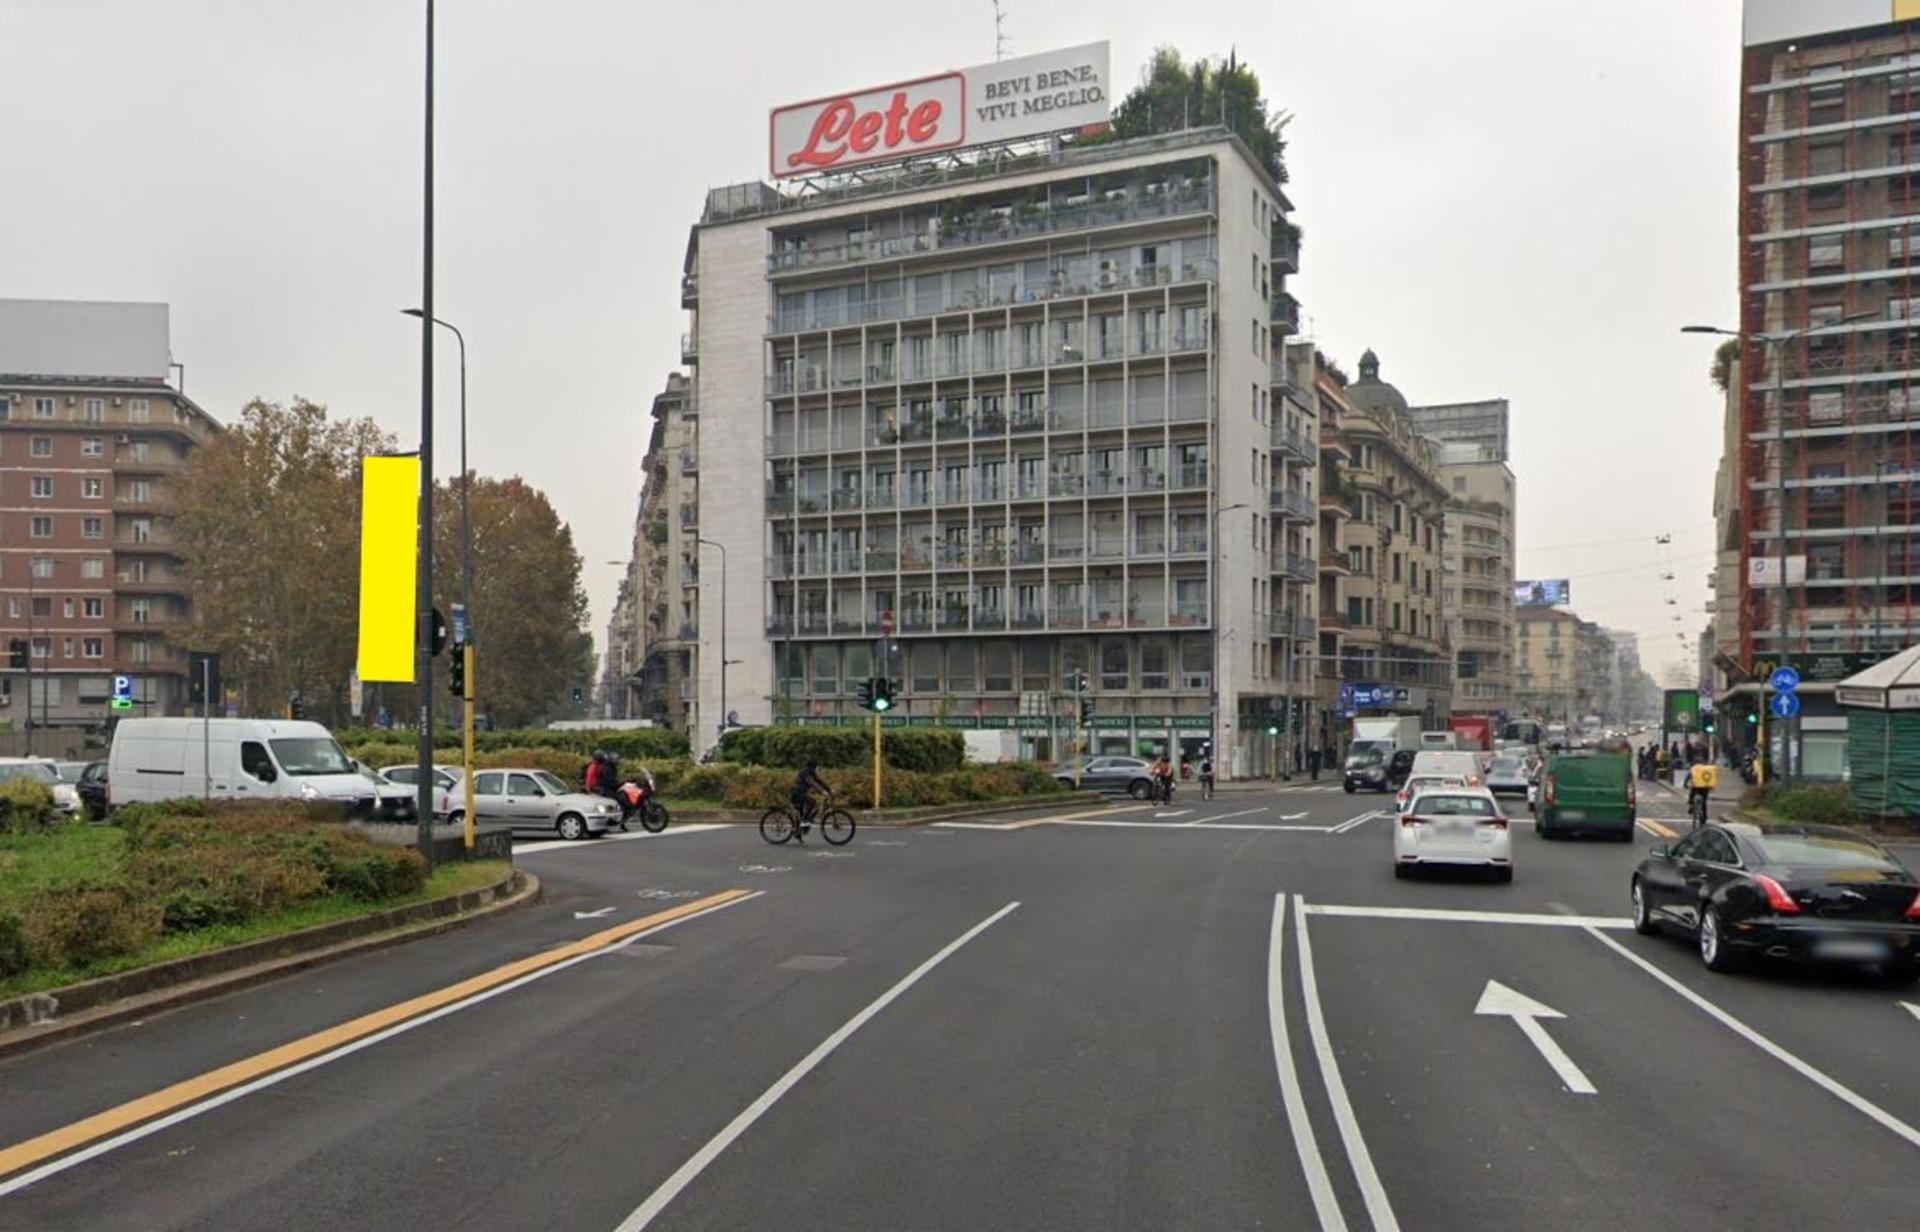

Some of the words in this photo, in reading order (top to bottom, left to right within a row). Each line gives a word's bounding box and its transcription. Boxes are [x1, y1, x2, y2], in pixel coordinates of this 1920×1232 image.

[985, 76, 1031, 101] BEVI
[1036, 64, 1098, 91] BENE,
[976, 101, 1017, 122] VIVI
[1023, 86, 1105, 116] MEGLIO.
[787, 91, 942, 167] Lete
[115, 676, 129, 695] P
